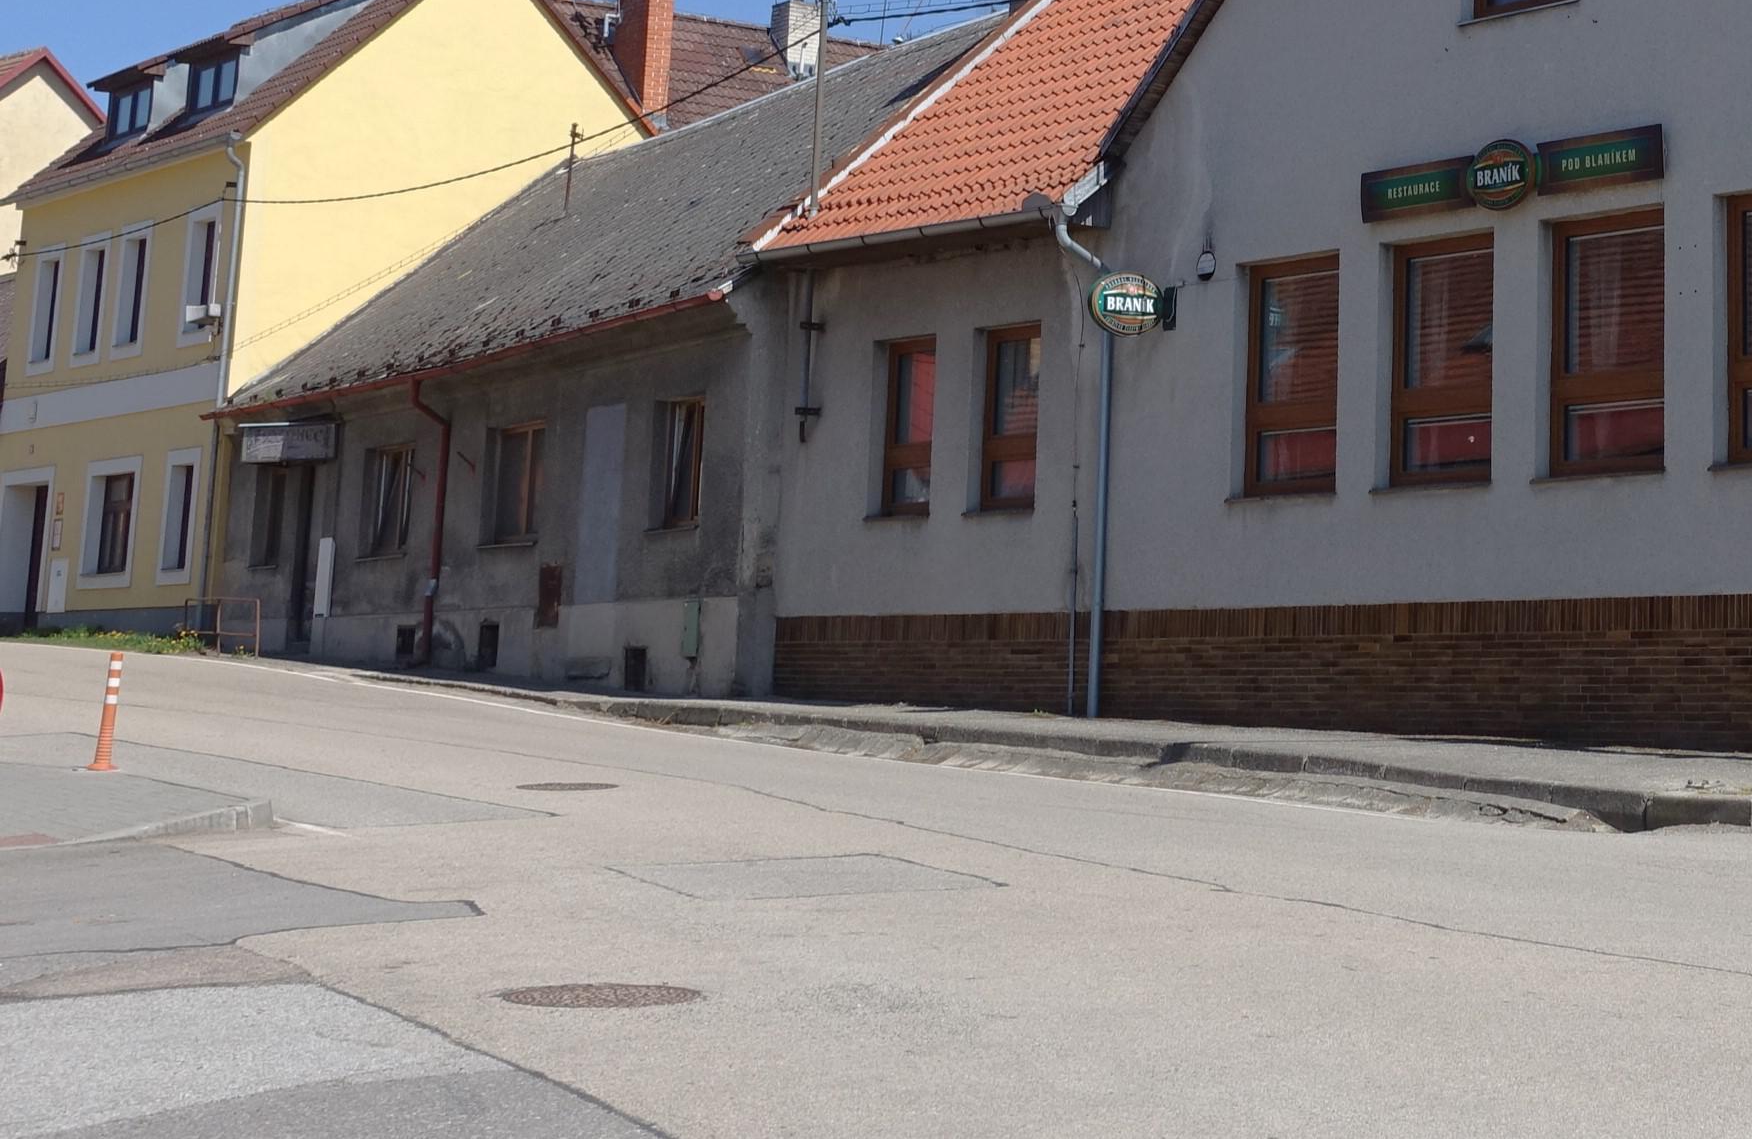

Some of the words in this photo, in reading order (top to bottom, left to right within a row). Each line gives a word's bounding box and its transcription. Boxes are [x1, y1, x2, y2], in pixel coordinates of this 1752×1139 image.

[1561, 157, 1580, 172] POD
[1585, 147, 1636, 168] BLANÍKEM
[1476, 162, 1521, 187] BRANÍK
[1387, 181, 1440, 199] RESTAURACE
[1106, 296, 1155, 314] BRANÍK
